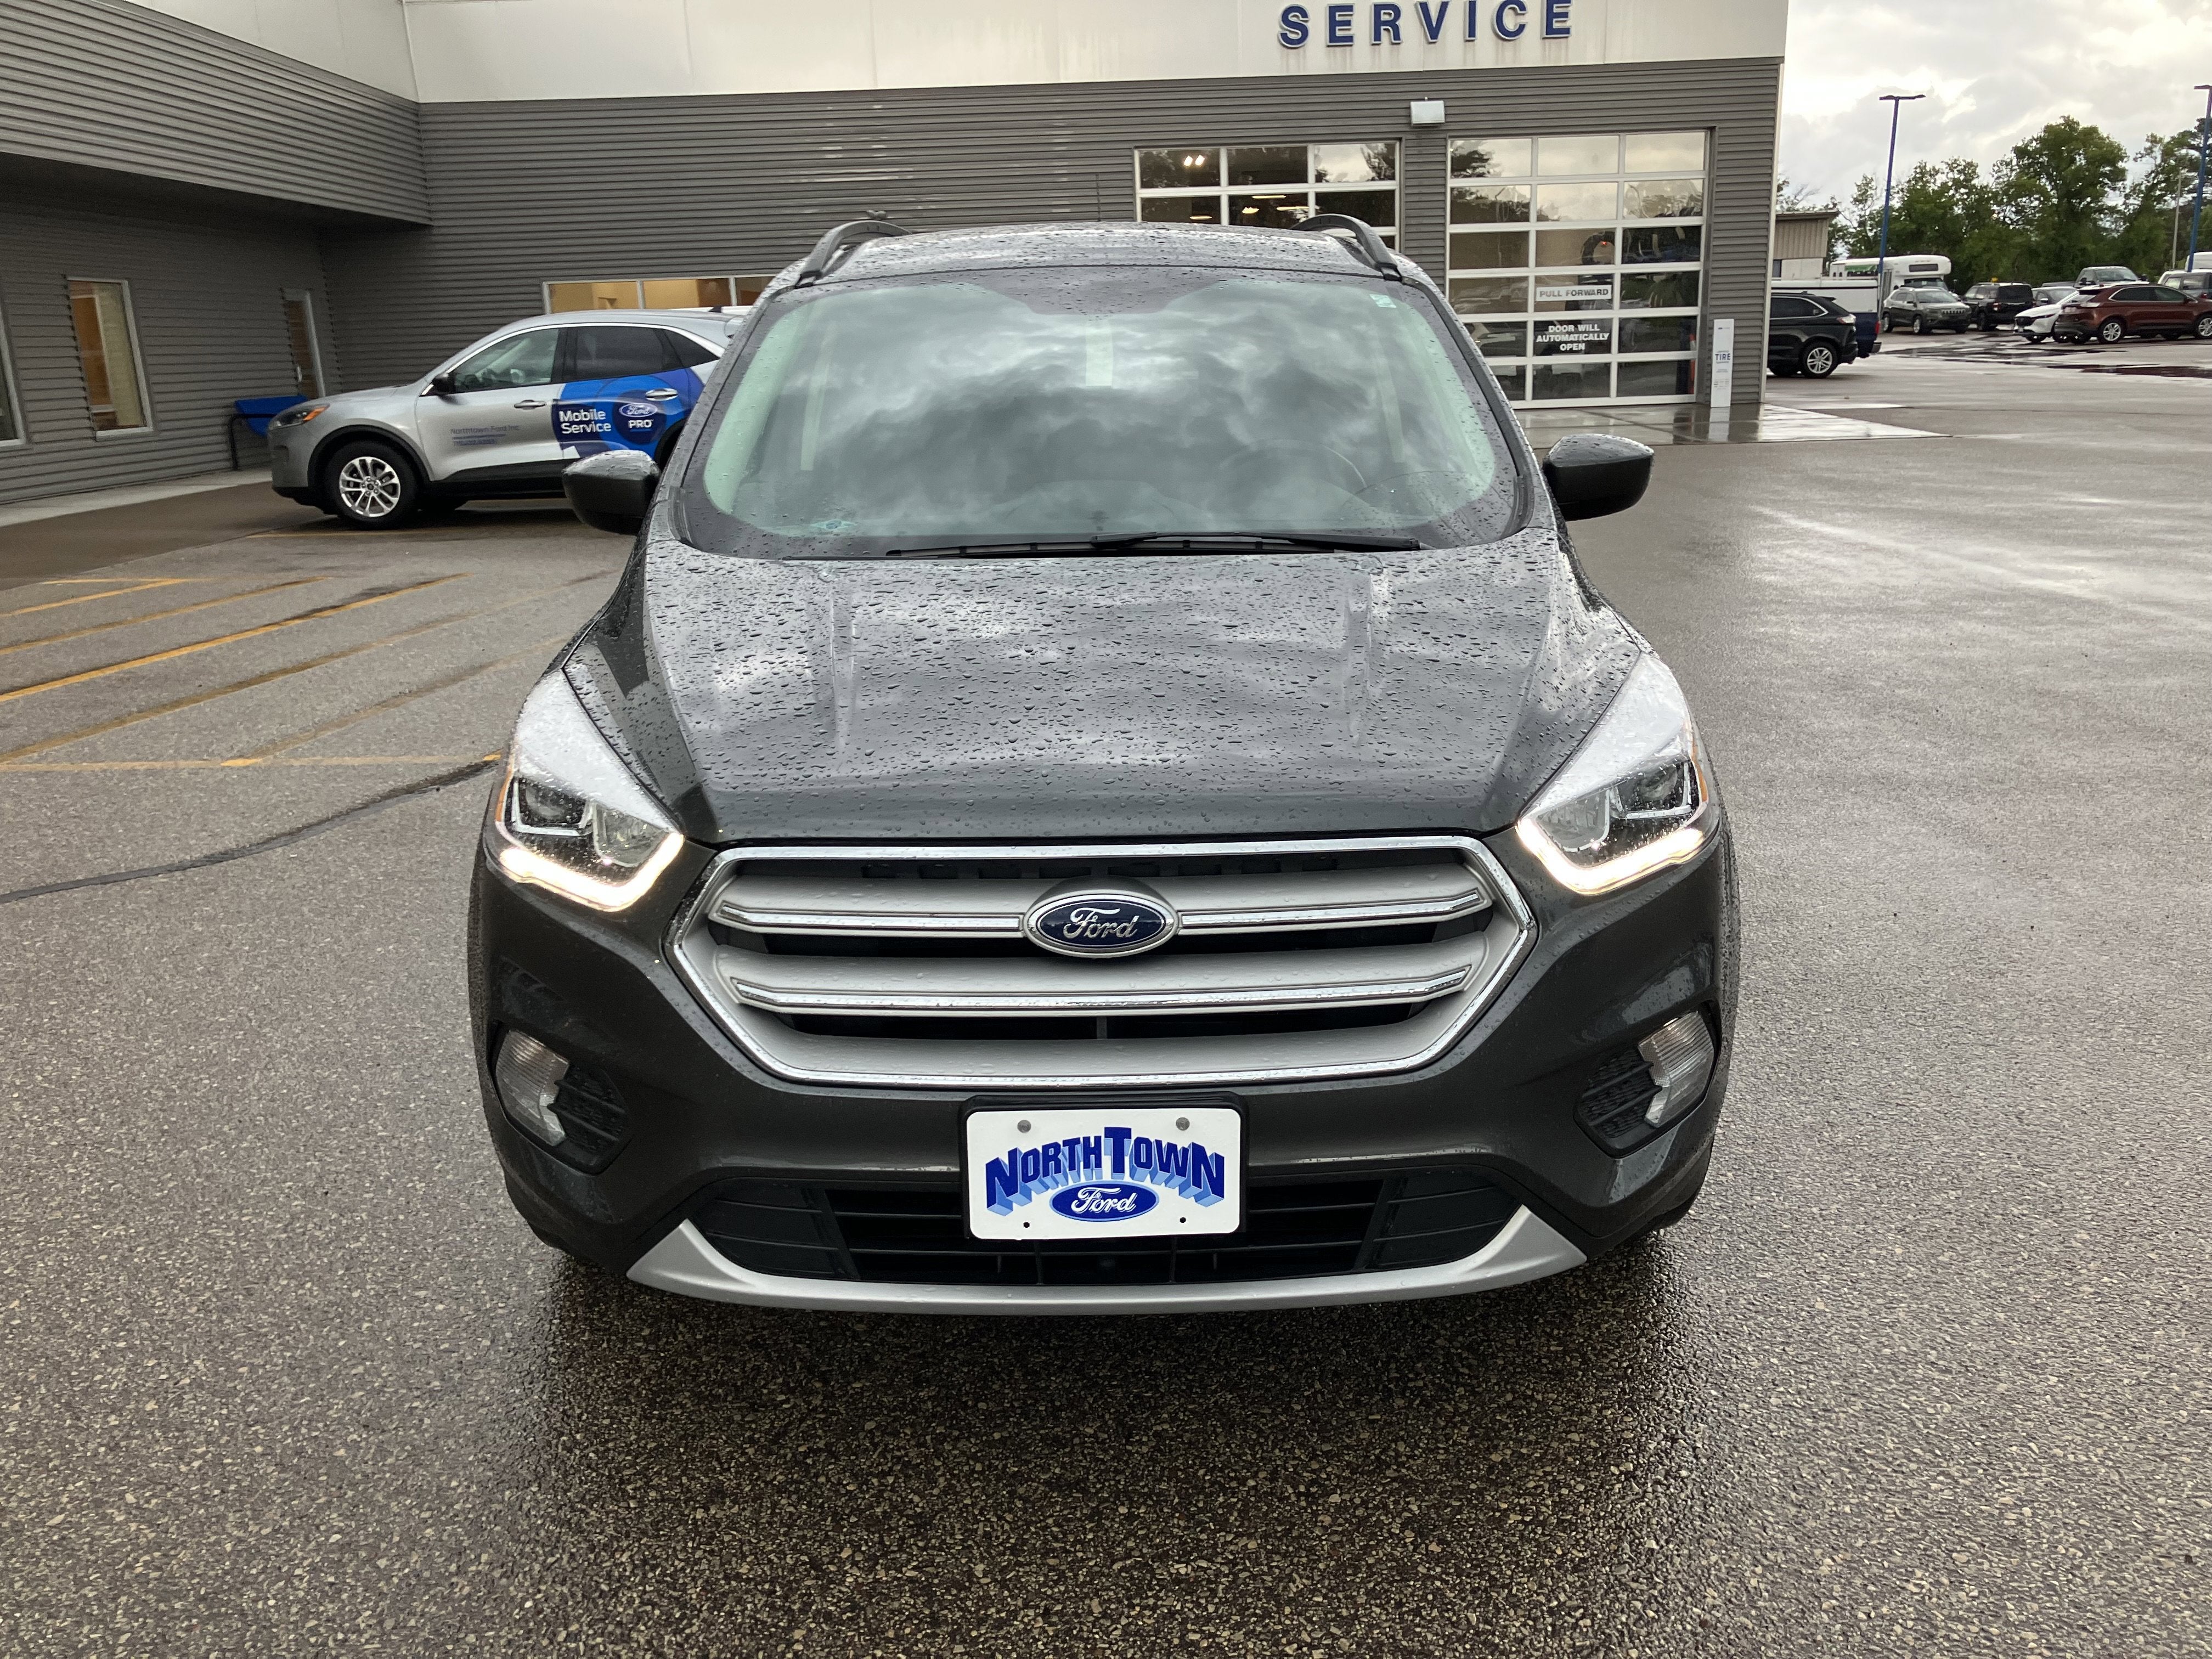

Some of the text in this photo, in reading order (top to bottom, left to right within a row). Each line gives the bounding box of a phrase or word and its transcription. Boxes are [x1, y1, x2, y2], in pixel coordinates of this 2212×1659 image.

[1278, 0, 1572, 48] SERVICE
[1566, 289, 1609, 297] FORWARD
[1536, 332, 1610, 342] AUTOMATICALLY
[1559, 343, 1585, 351] OPEN
[559, 408, 606, 422] Mobile
[627, 405, 650, 415] Ford
[561, 421, 612, 434] Service
[1063, 907, 1139, 939] Ford
[1071, 1187, 1138, 1213] Ford
